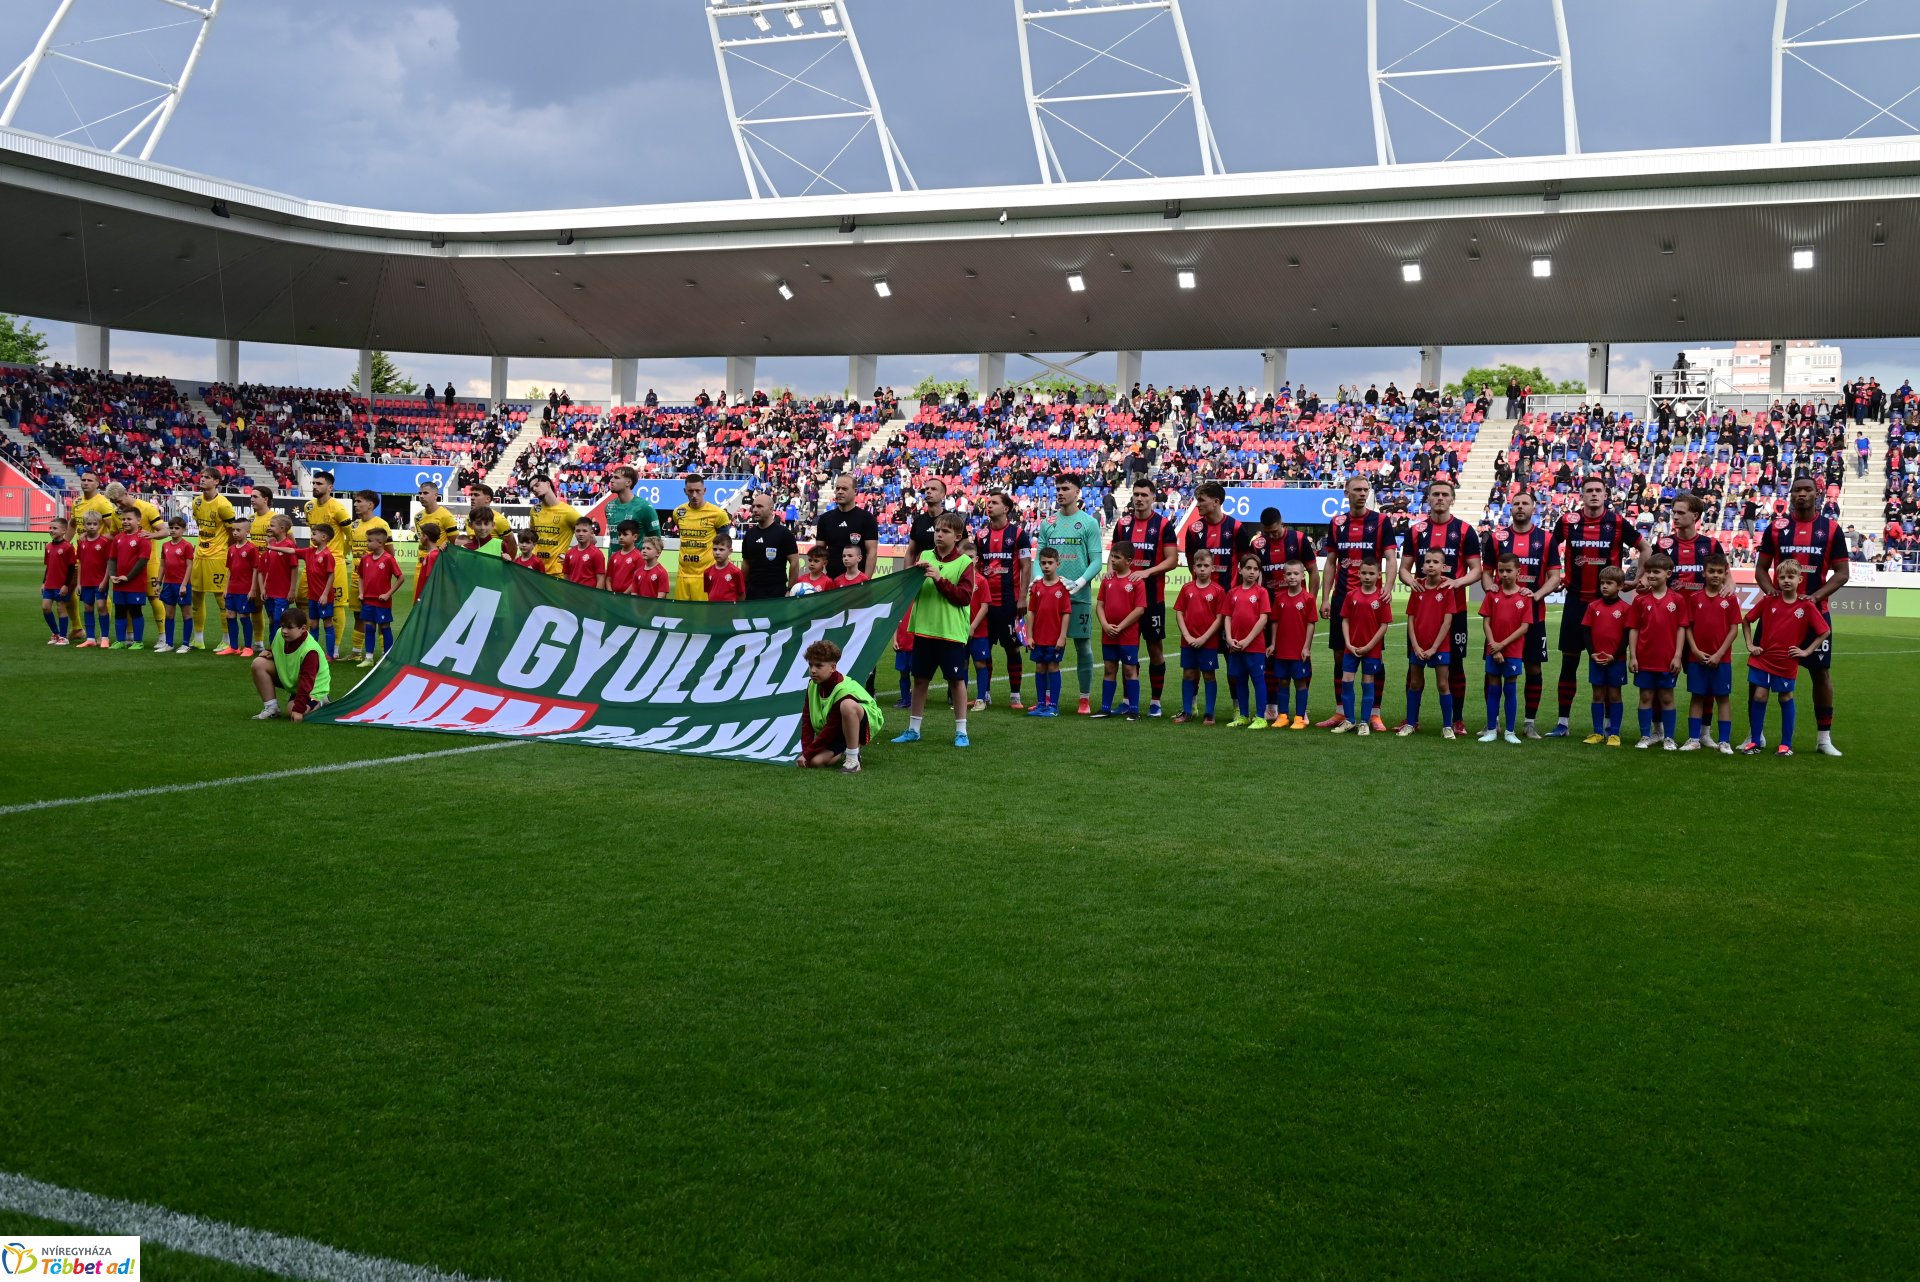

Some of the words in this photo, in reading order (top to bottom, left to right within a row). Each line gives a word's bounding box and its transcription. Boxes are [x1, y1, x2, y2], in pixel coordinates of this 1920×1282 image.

[415, 472, 443, 489] C8
[636, 486, 660, 504] C8
[1220, 495, 1250, 516] C6
[213, 573, 225, 584] 27
[1830, 601, 1883, 611] estito
[1079, 614, 1089, 625] 57
[1151, 615, 1161, 627] 31
[1454, 632, 1467, 644] 98
[1541, 636, 1547, 648] 7
[420, 586, 501, 675] A
[497, 601, 893, 704] GYŰLÖLET
